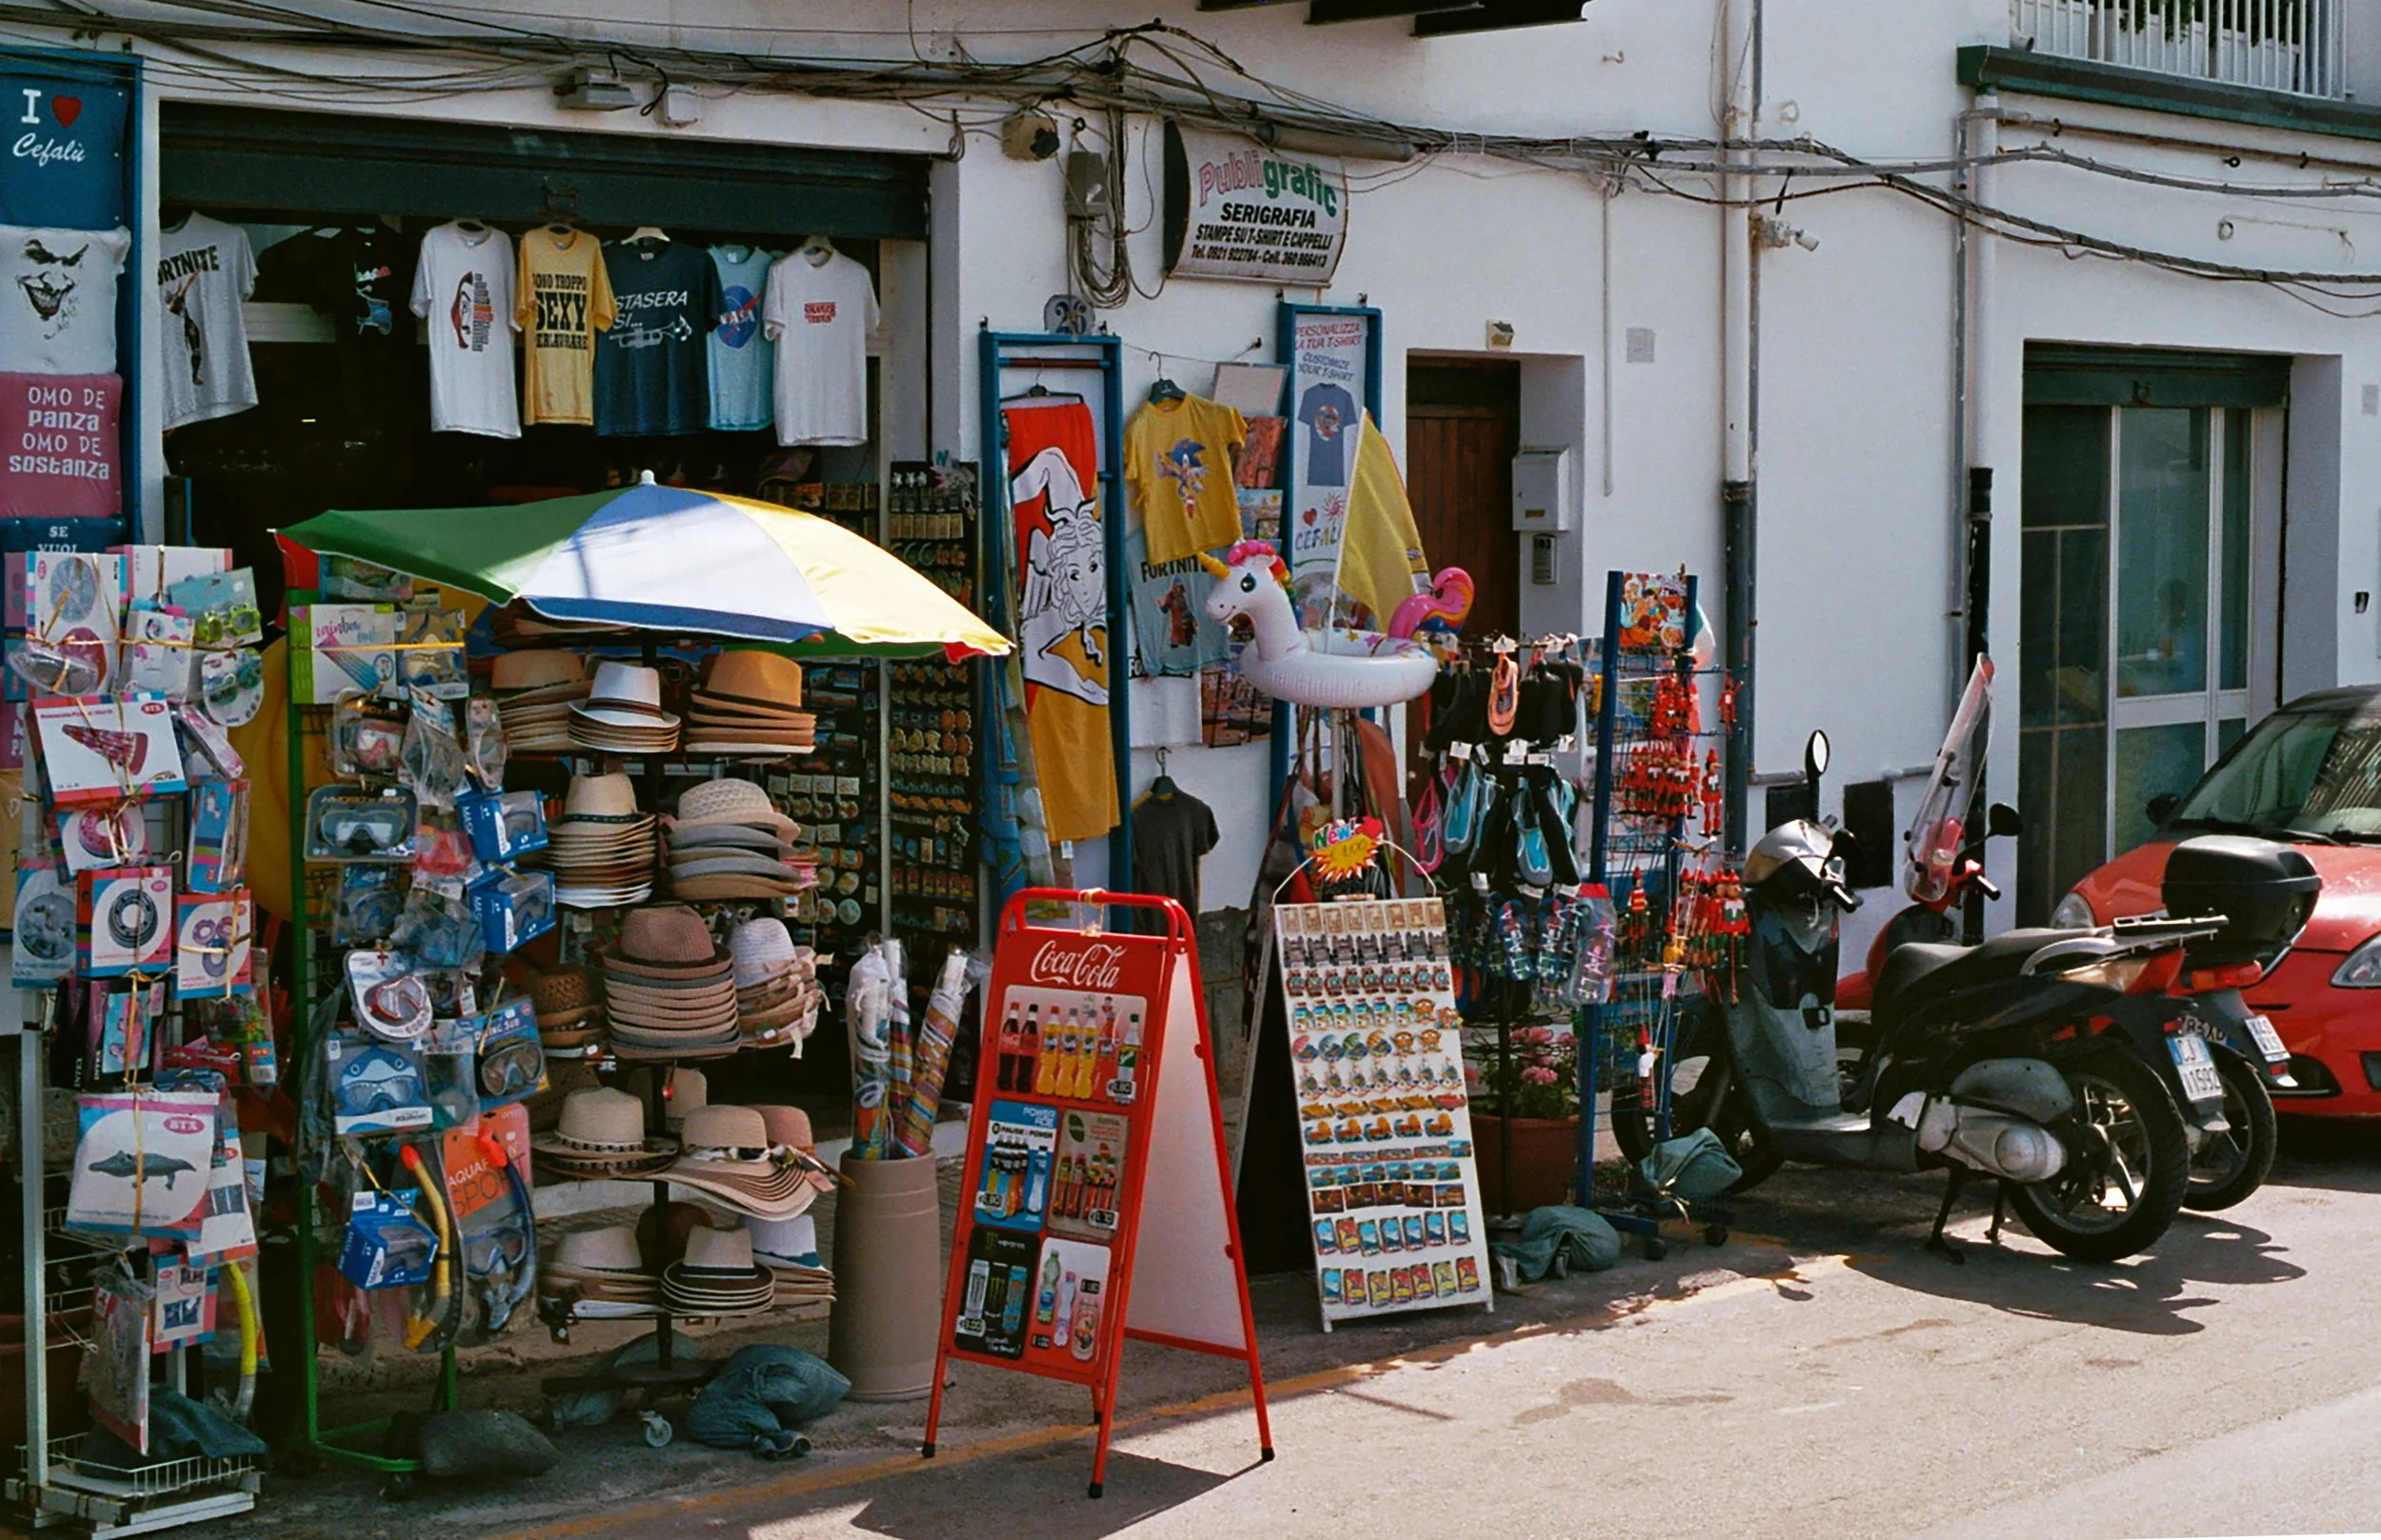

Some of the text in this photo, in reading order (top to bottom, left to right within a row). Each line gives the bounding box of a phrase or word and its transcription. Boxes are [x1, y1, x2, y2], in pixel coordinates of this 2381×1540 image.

[21, 89, 42, 125] I
[12, 132, 86, 167] Cefalù
[1221, 202, 1316, 229] SERIGRAFIA
[1195, 224, 1333, 250] STAMPE SU T-SHIRT E CAPPELLI
[157, 245, 220, 286] ORTNITE
[554, 274, 588, 290] TROPPO
[534, 290, 588, 331] SEXY
[613, 290, 688, 310] STASERA
[28, 387, 106, 410] OMO DE
[22, 432, 102, 457] OMO DE
[49, 526, 69, 538] SE
[1030, 940, 1128, 989] Coca-Cola
